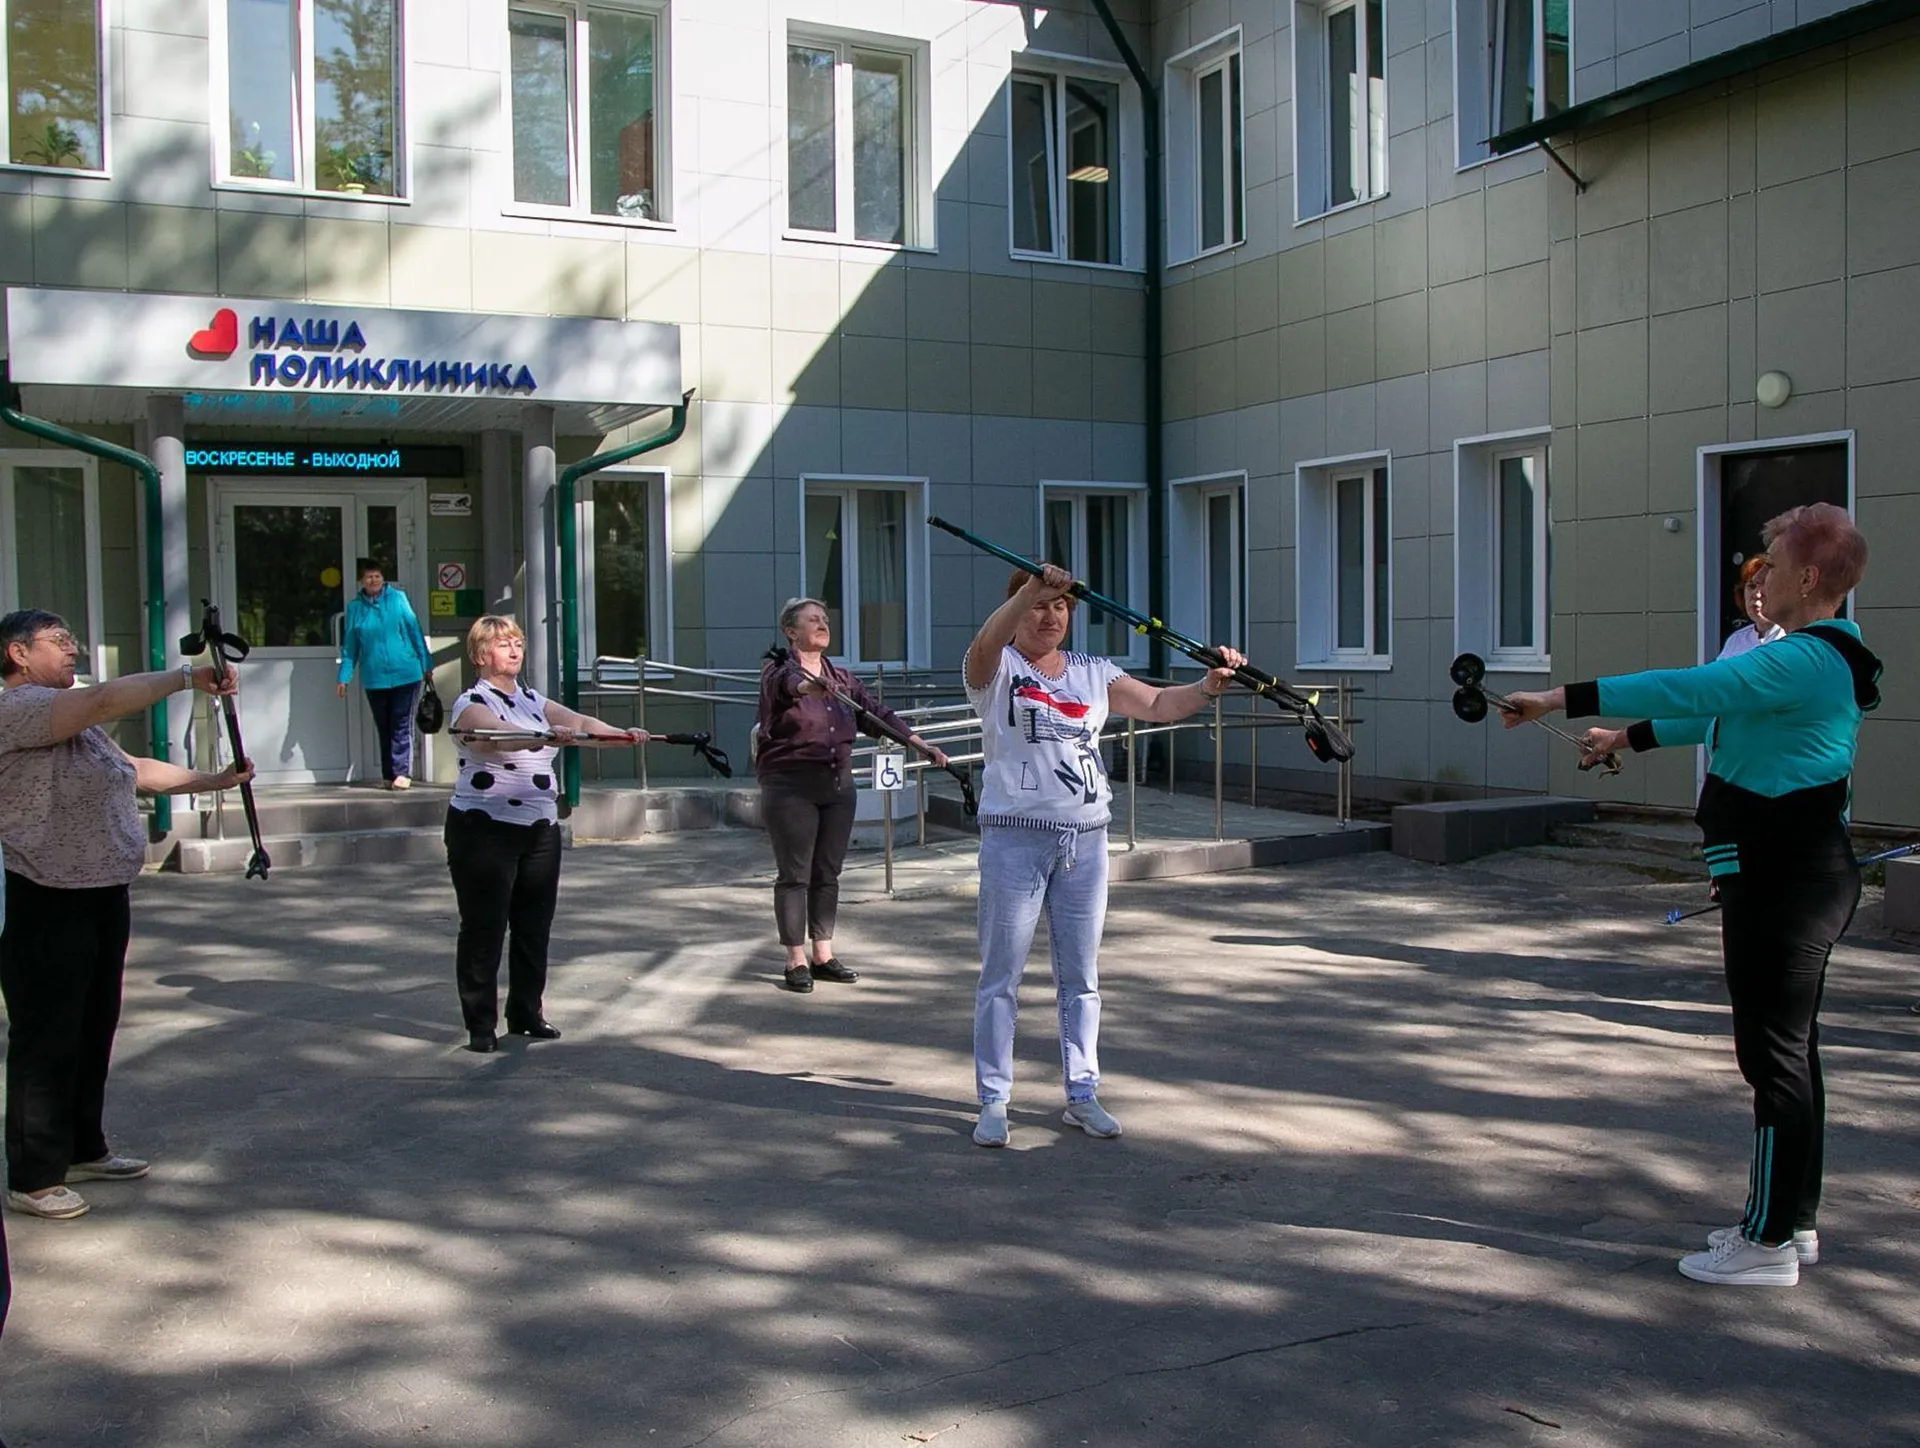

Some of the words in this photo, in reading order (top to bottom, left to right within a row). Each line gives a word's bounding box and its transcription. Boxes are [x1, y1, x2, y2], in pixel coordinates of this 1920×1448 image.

[251, 316, 367, 352] НАША
[251, 353, 538, 394] ПОЛИКЛИНИКА
[185, 450, 295, 466] ВОСКРЕСЕНЬЕ
